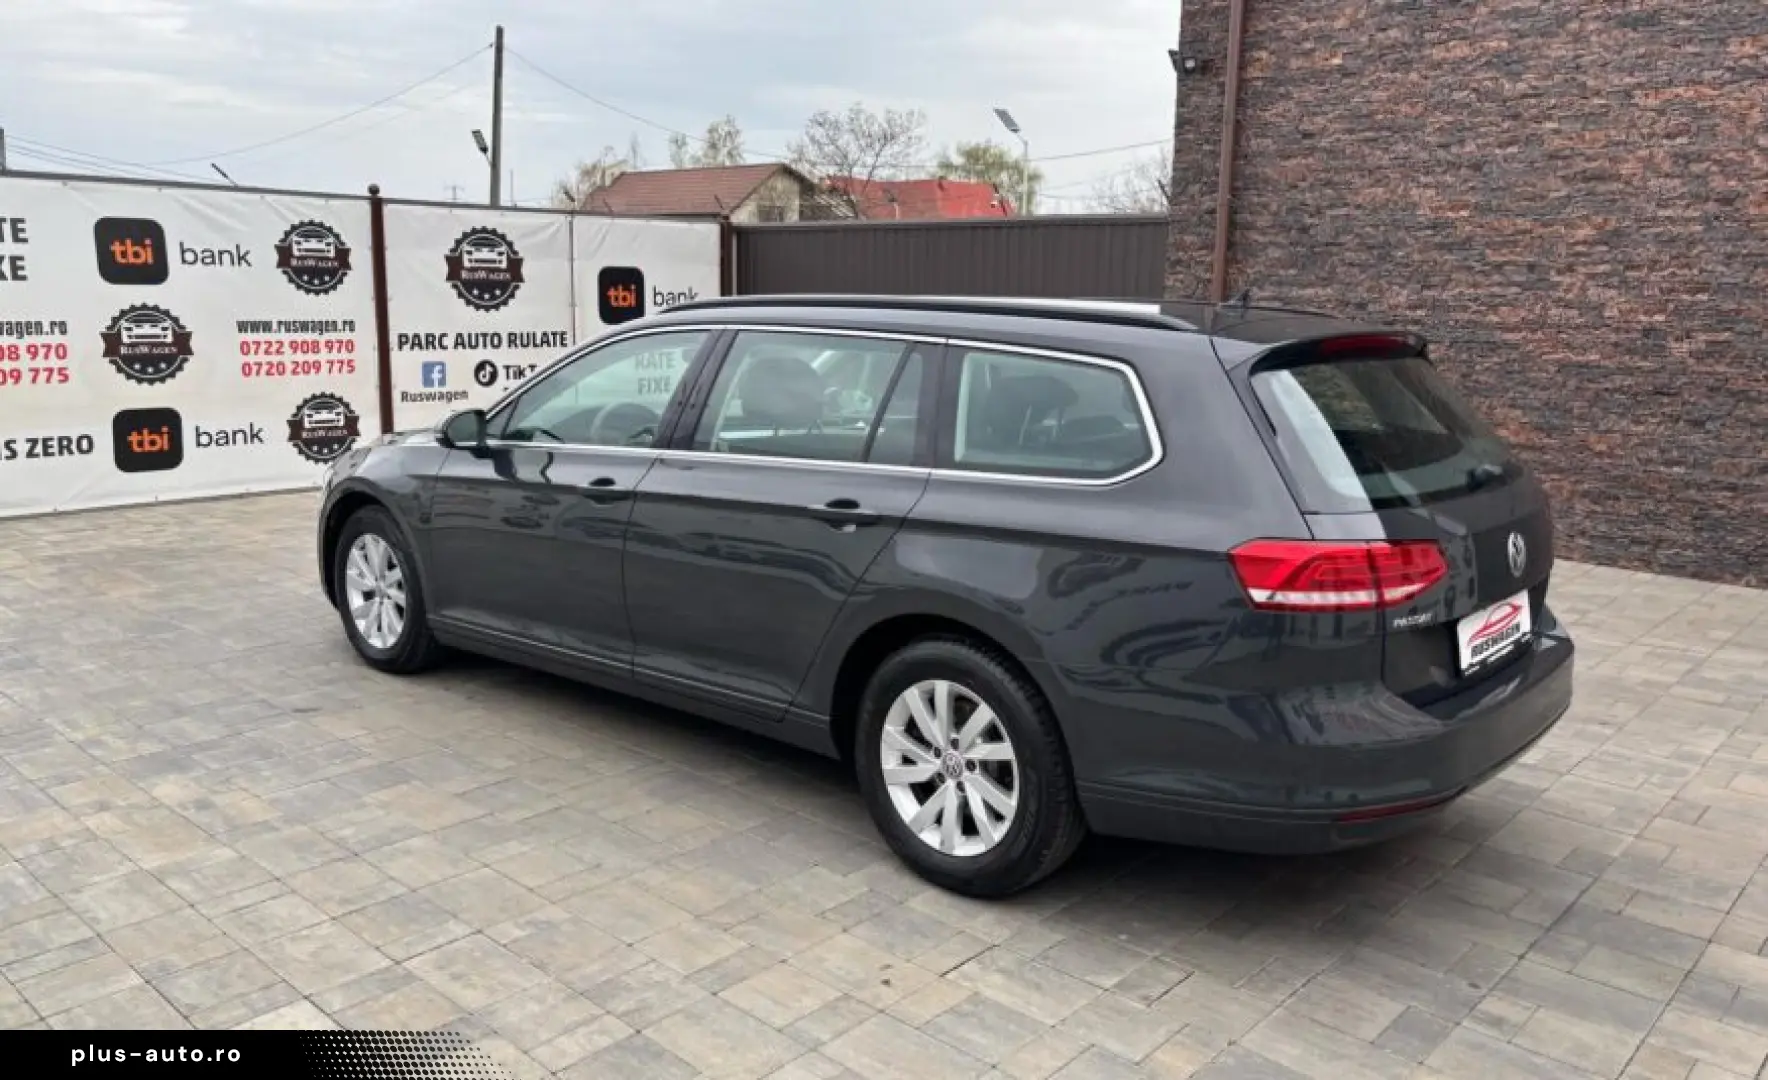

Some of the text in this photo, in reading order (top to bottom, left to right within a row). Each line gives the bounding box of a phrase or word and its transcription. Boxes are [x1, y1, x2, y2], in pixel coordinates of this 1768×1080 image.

[111, 238, 252, 268] tbi bank
[607, 283, 637, 308] tbi
[236, 320, 356, 336] www.ruswagen.ro
[239, 339, 354, 356] 0722 908 970
[397, 331, 568, 351] PARC AUTO RULATE
[26, 343, 68, 361] 970
[28, 367, 70, 384] 775
[241, 359, 355, 377] 0720 209 775
[400, 390, 469, 404] Ruswagen
[25, 434, 95, 459] ZERO
[128, 423, 265, 453] tbi bank
